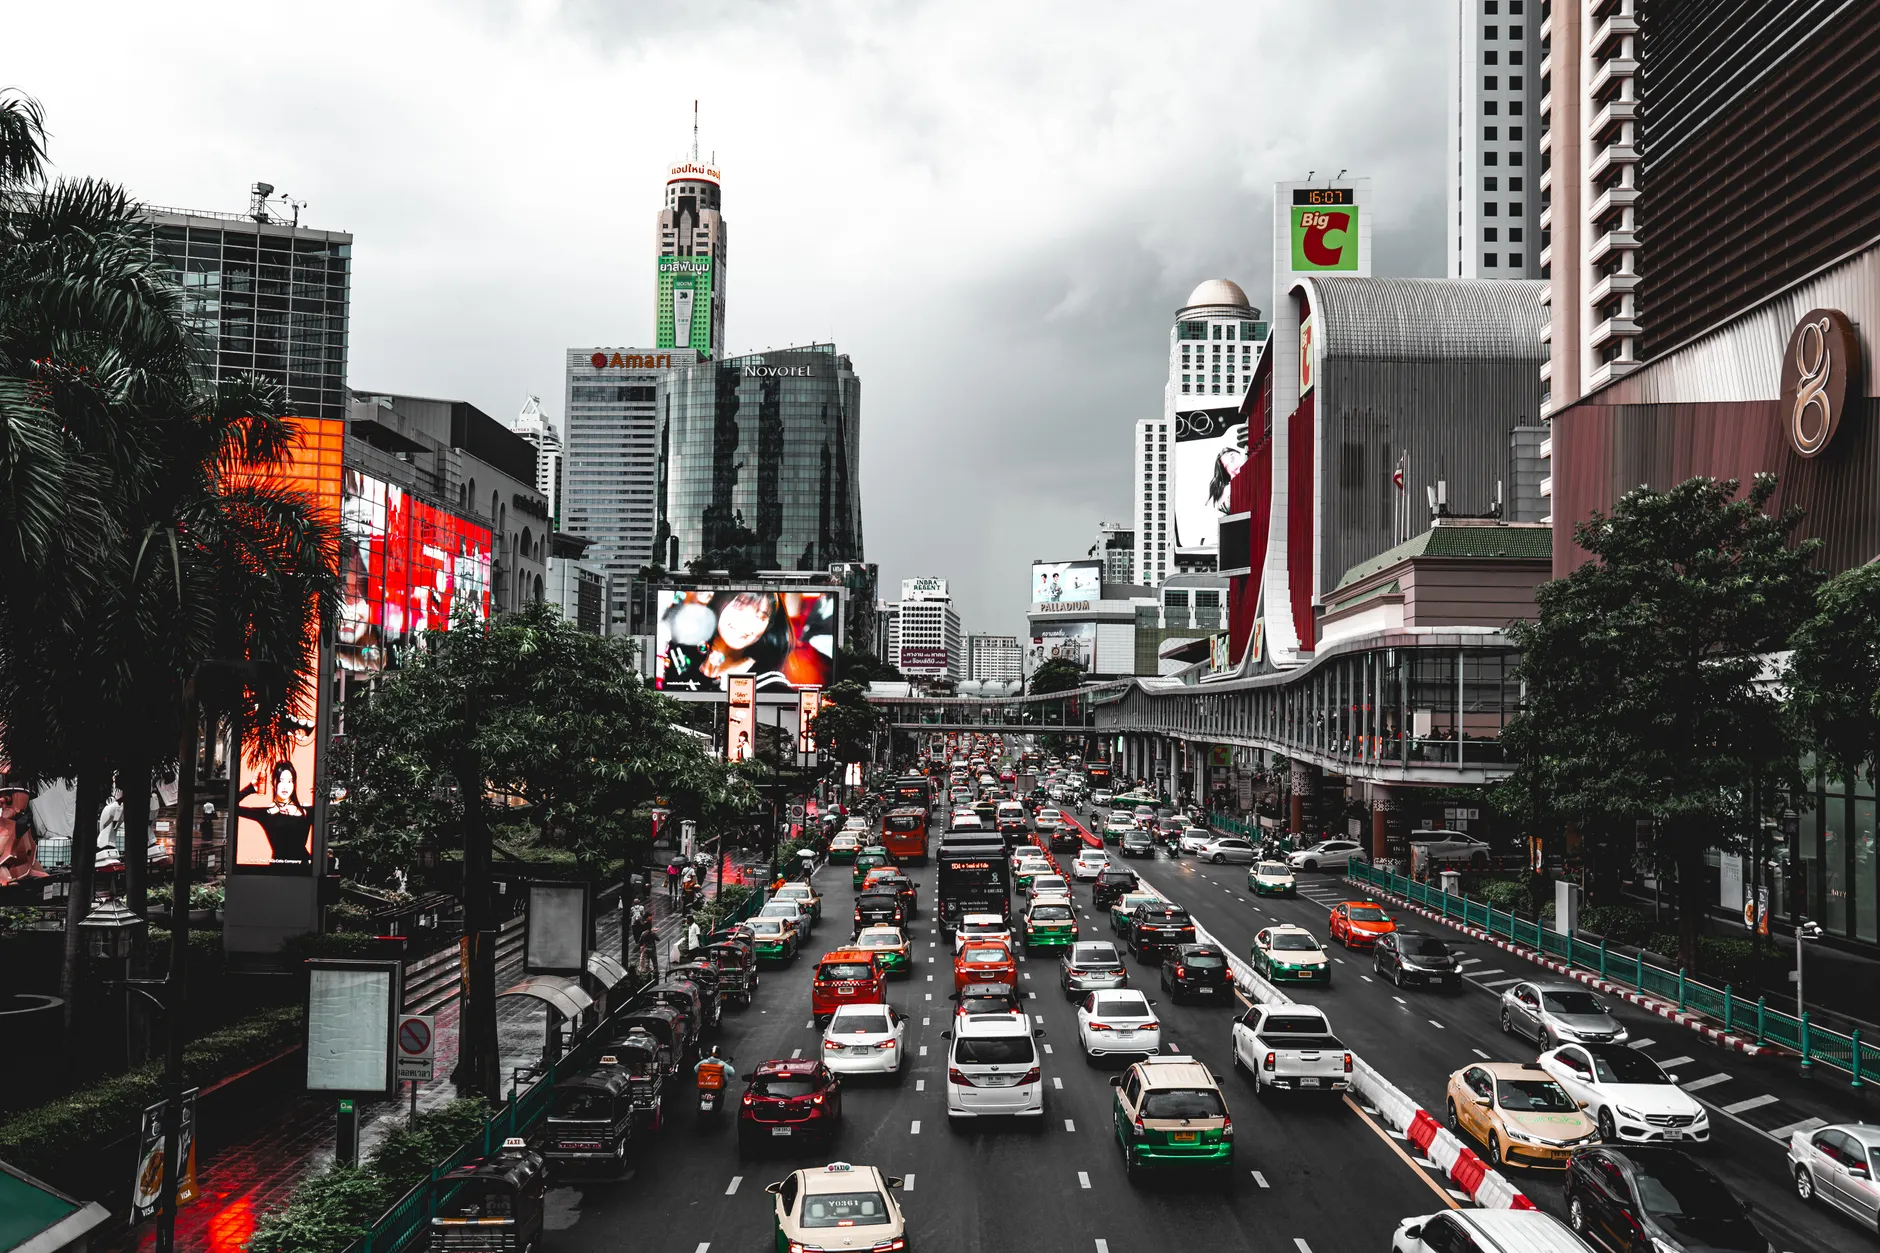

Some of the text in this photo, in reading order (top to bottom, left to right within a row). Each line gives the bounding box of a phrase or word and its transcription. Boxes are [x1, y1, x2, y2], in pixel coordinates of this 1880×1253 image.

[1309, 191, 1343, 204] 16:07
[1301, 211, 1330, 230] Big
[1303, 211, 1351, 267] C
[660, 260, 710, 275] ยาสีฟันบูม
[608, 352, 672, 369] Amari
[745, 365, 816, 377] NOVOTEL
[1041, 600, 1090, 612] PALLADIUM
[180, 1188, 192, 1200] VISA
[141, 1205, 155, 1217] VISA
